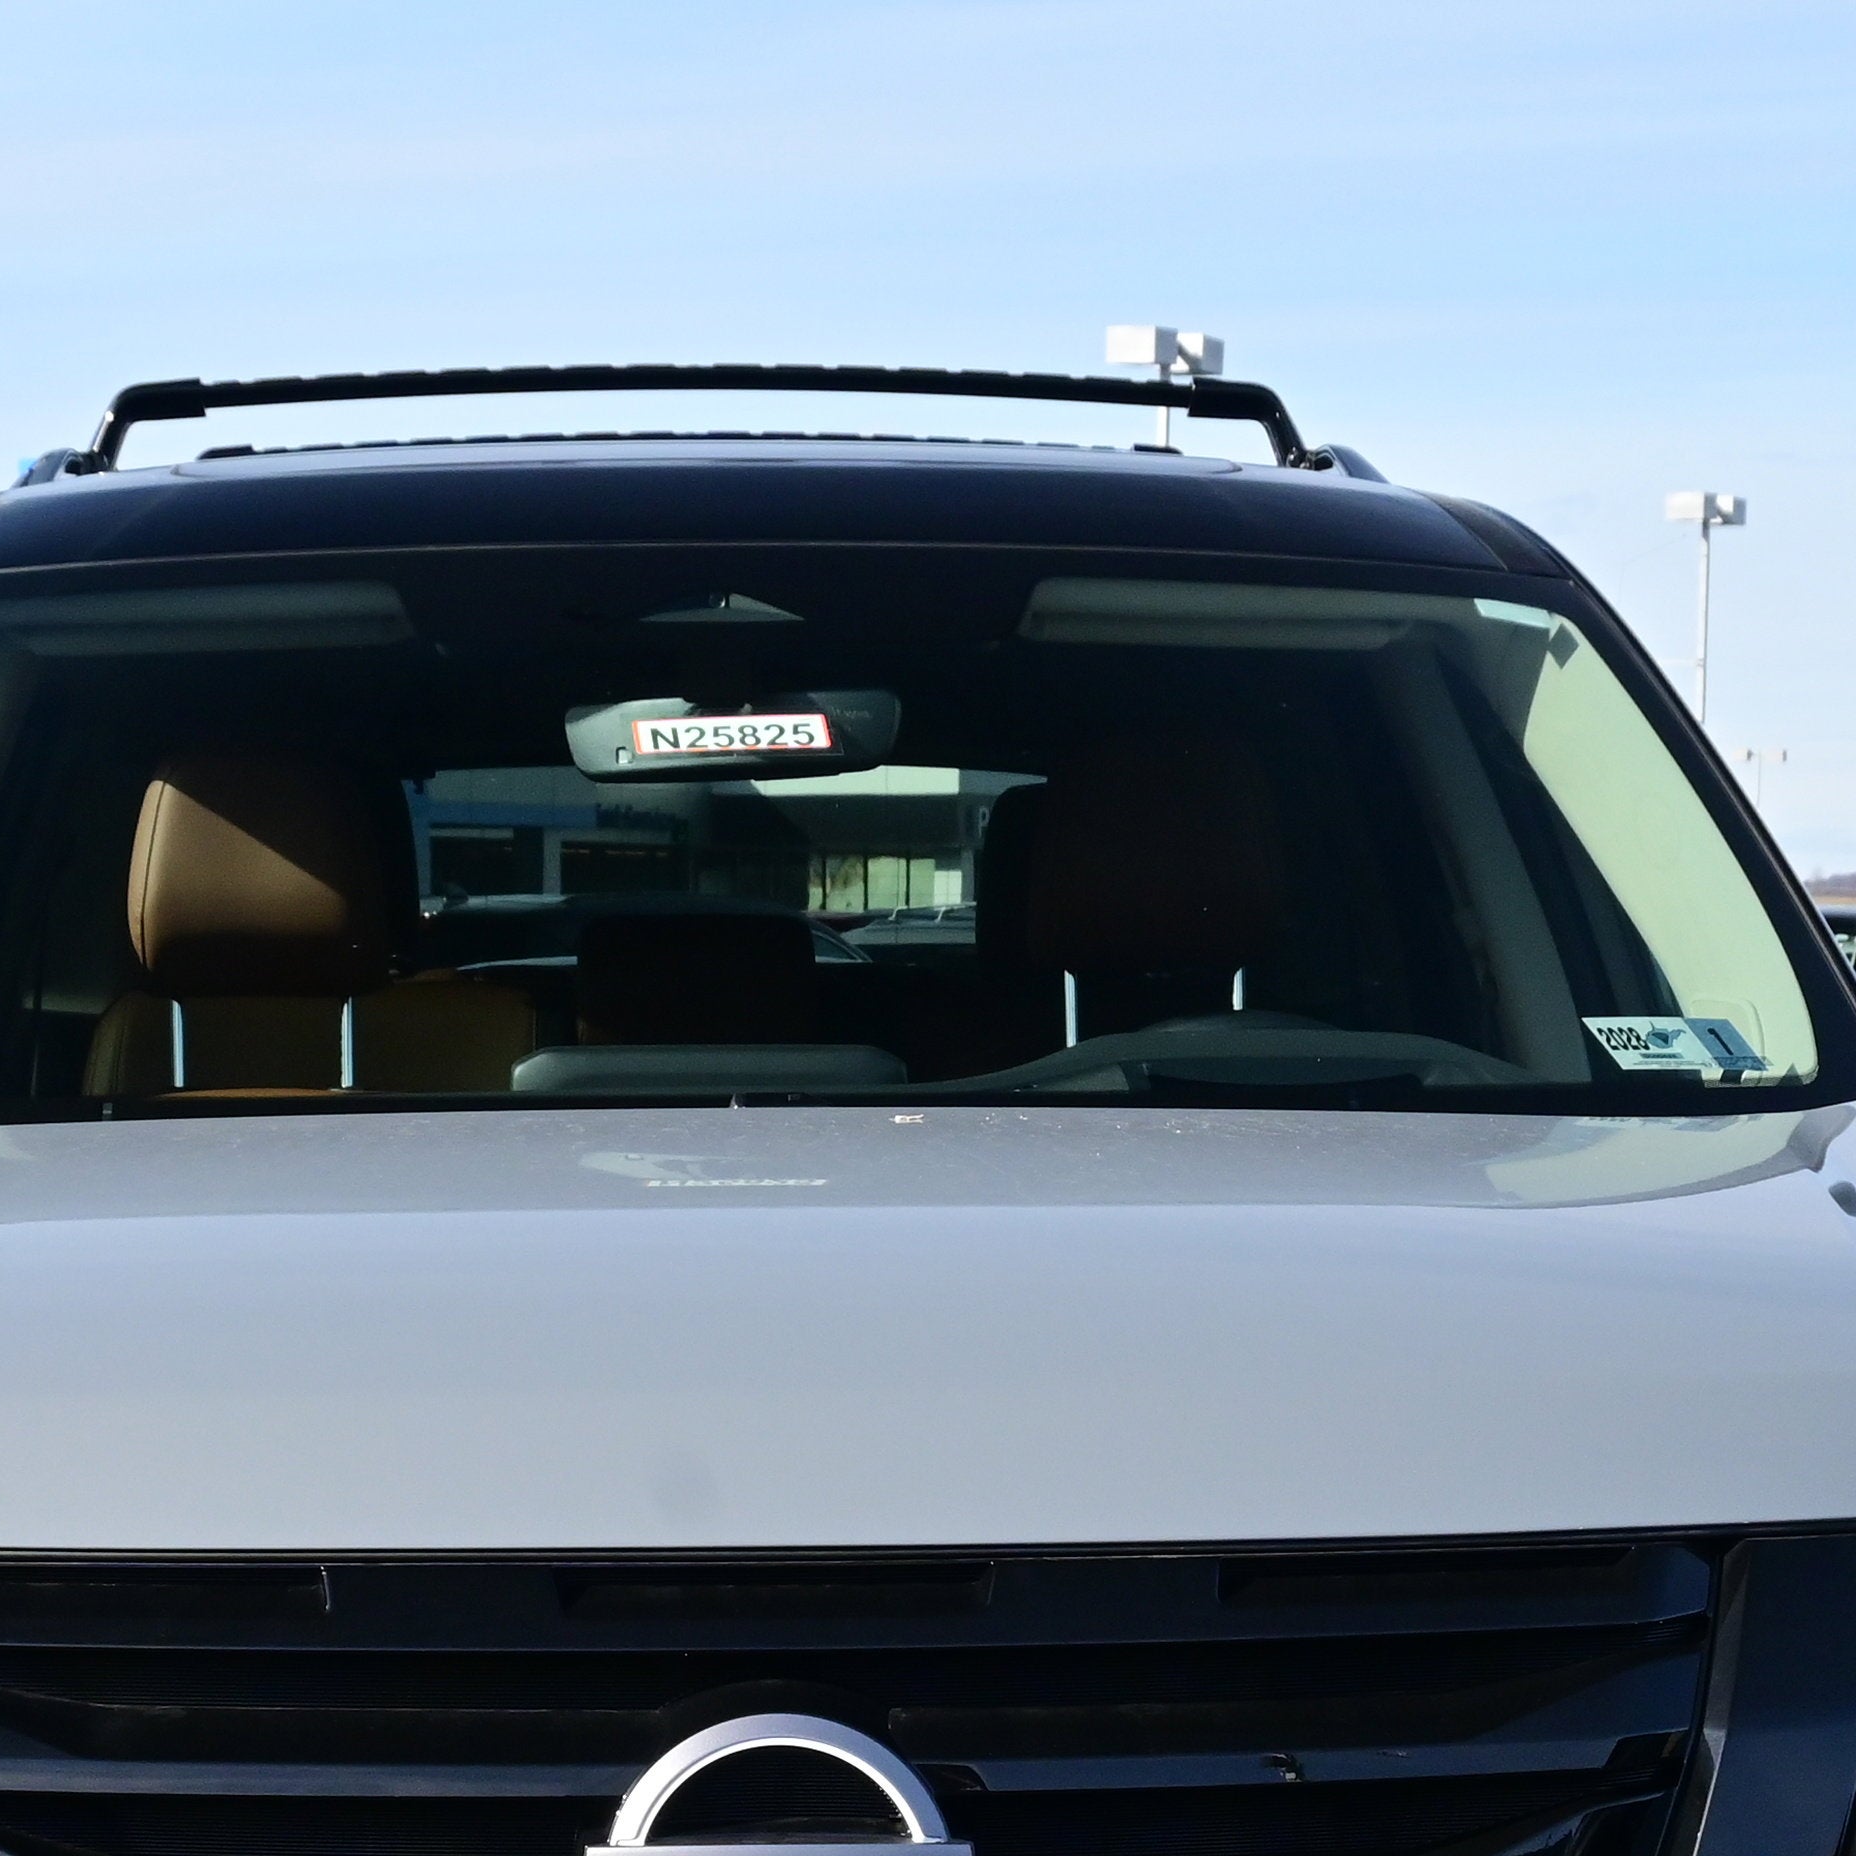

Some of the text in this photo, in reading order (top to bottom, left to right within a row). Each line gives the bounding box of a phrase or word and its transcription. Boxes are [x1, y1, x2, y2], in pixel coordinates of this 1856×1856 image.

[650, 722, 816, 750] N25825
[1596, 1026, 1734, 1056] 2028 1
